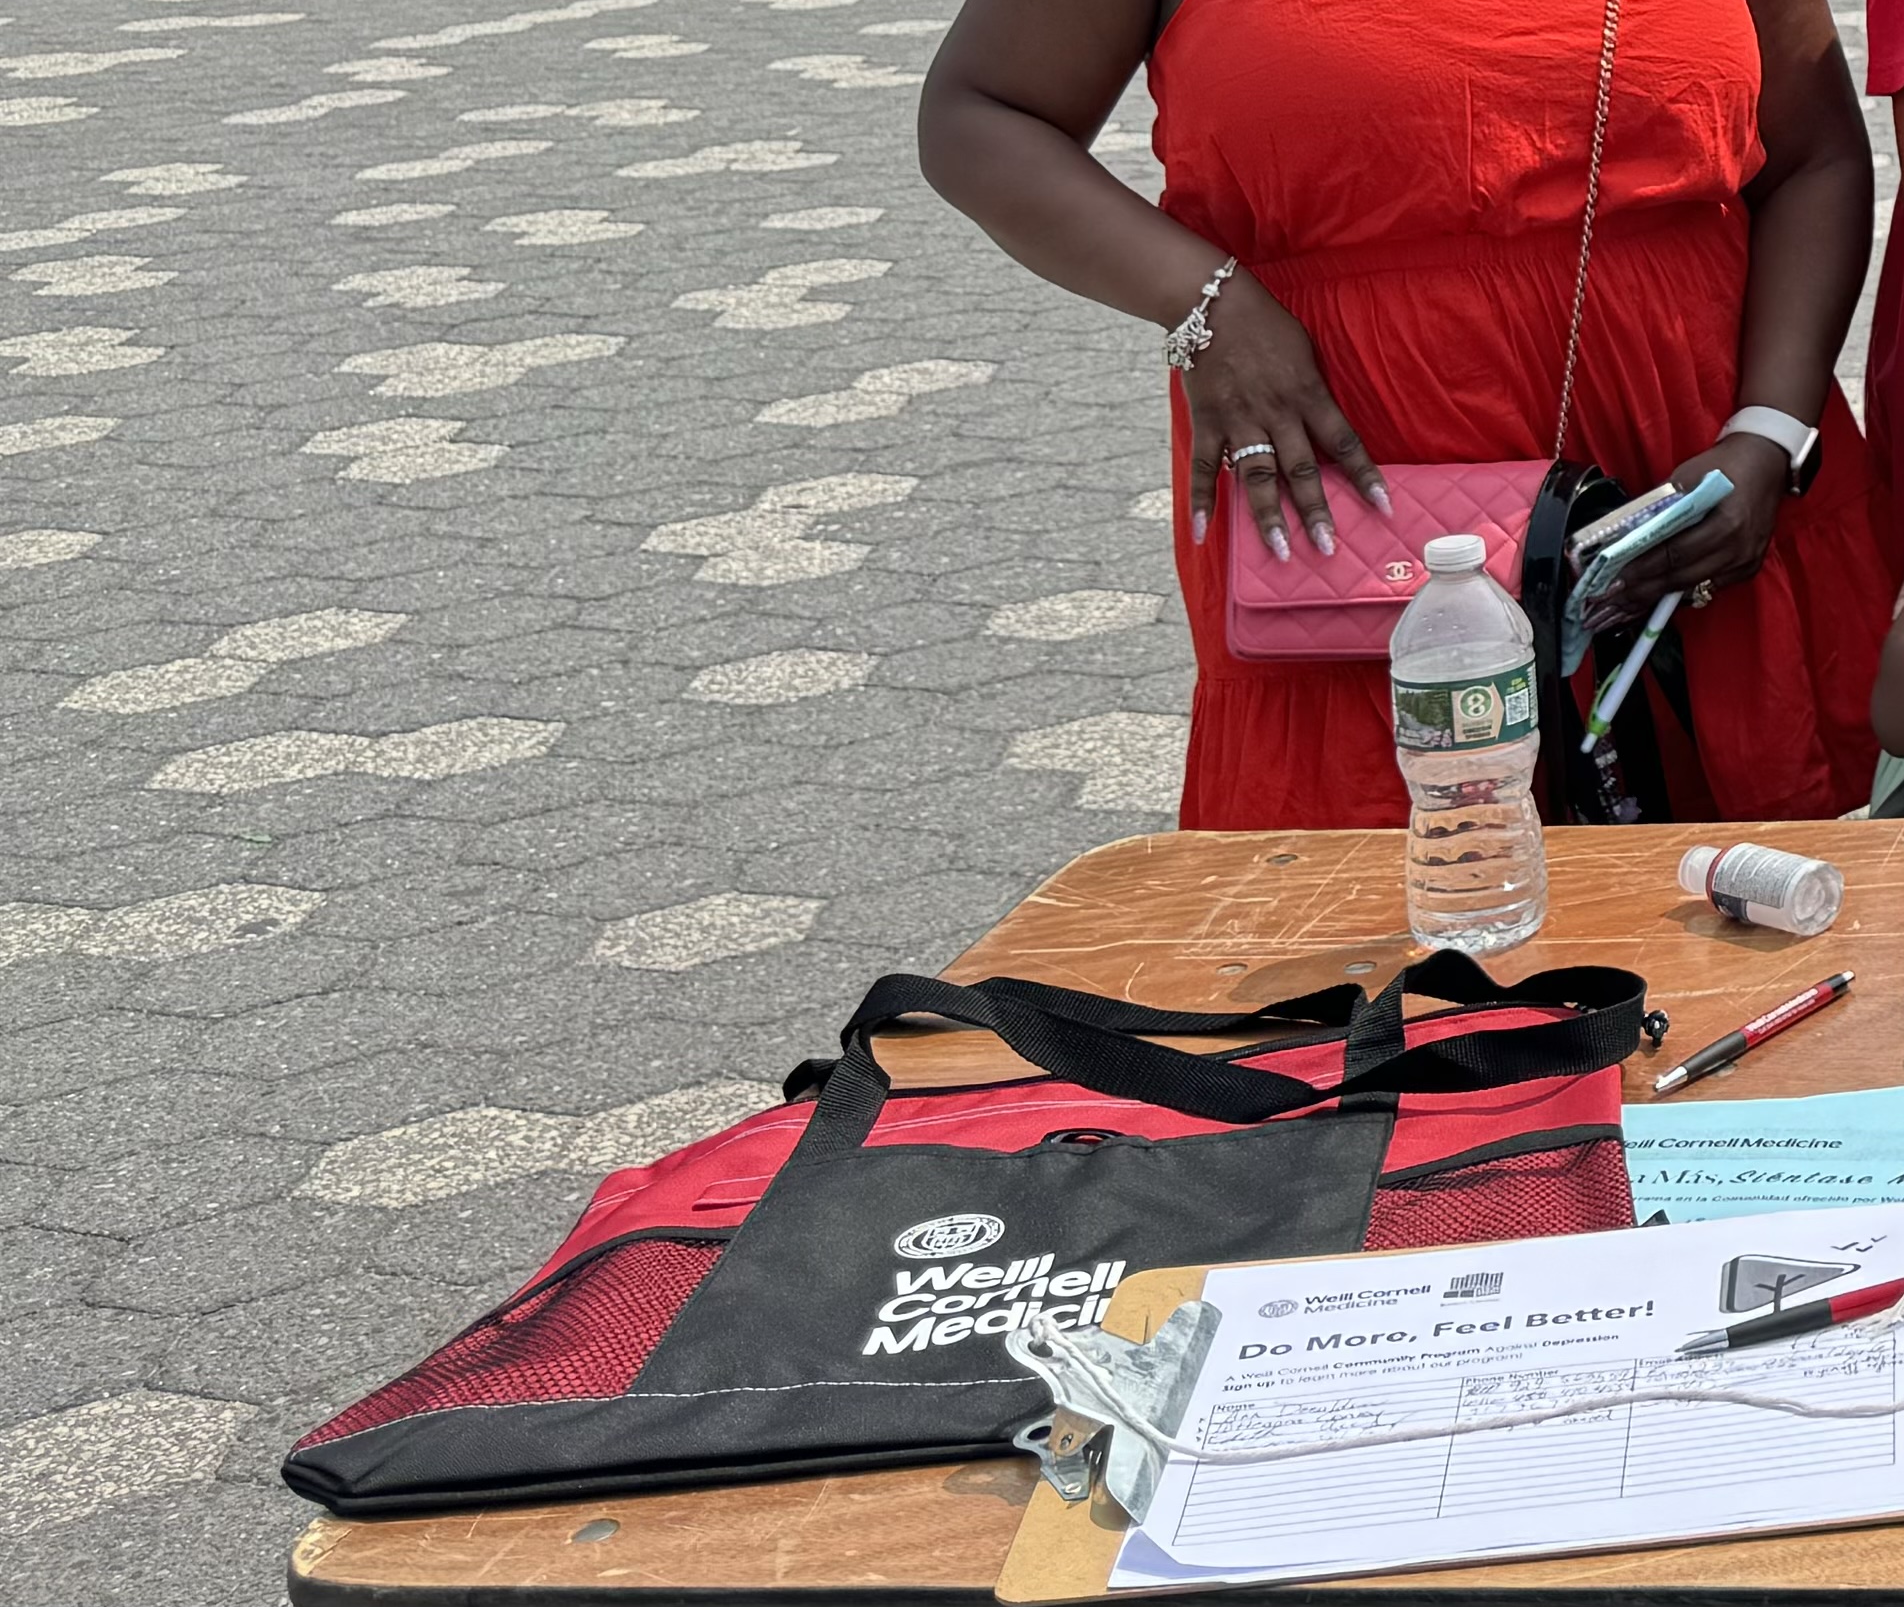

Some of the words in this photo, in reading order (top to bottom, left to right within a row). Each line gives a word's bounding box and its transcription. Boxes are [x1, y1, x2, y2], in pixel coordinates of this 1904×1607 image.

[1658, 1138, 1741, 1149] Cornell
[1741, 1137, 1842, 1149] Medicine
[896, 1253, 1055, 1295] Weill
[878, 1260, 1126, 1322] Cornell
[1304, 1290, 1355, 1305] Weill
[1357, 1285, 1432, 1301] Cornell
[1304, 1298, 1399, 1315] Medicine
[1238, 1343, 1293, 1361] Do
[1305, 1328, 1417, 1352] More,
[1433, 1315, 1512, 1338] Feel
[1526, 1300, 1655, 1328] Better!
